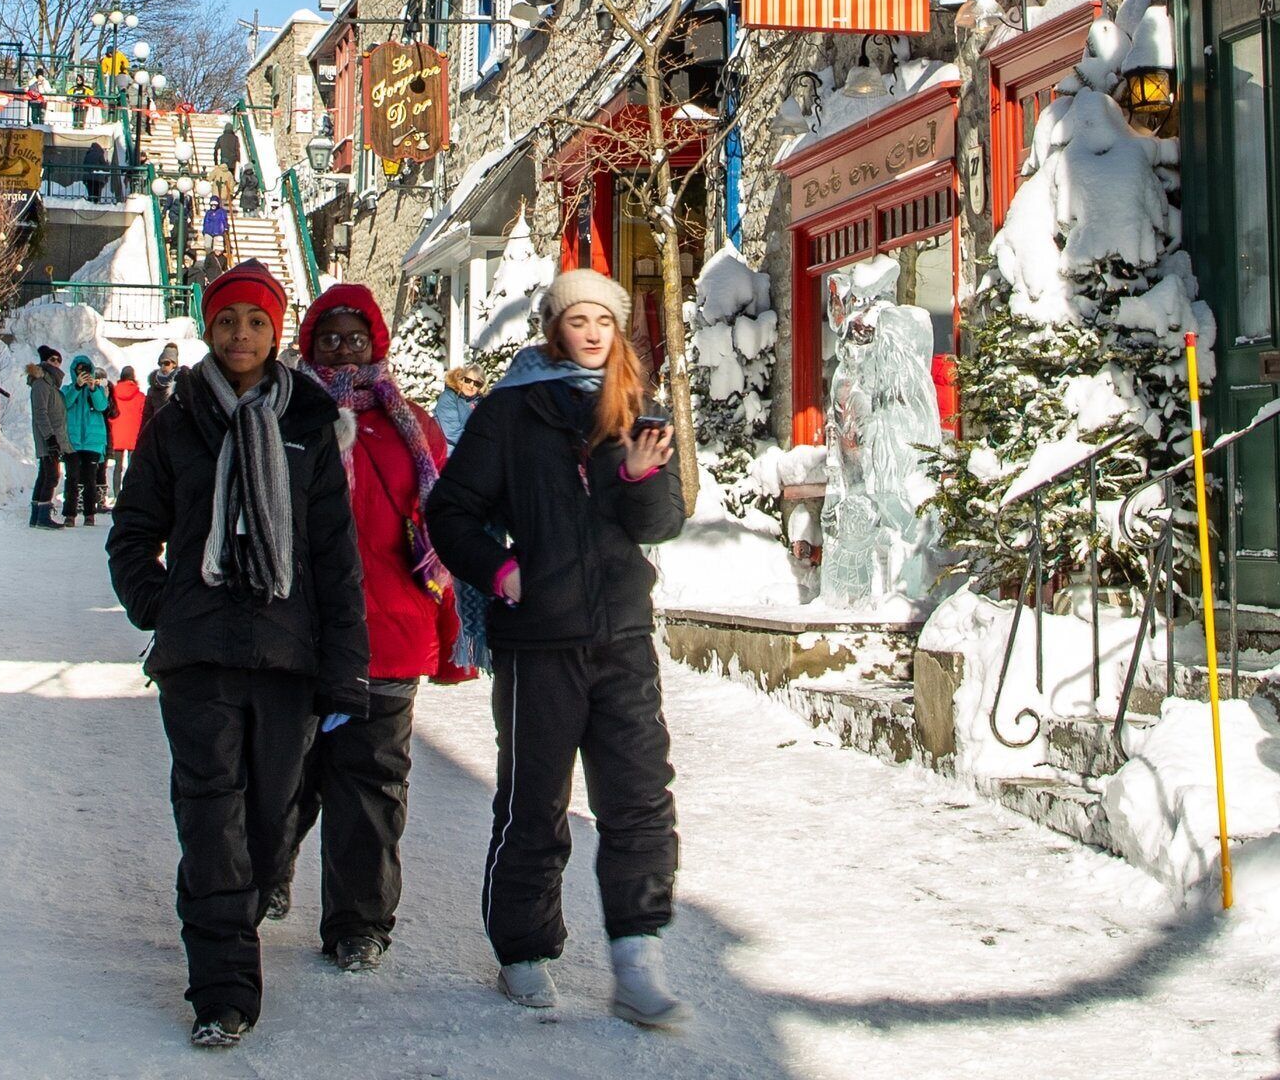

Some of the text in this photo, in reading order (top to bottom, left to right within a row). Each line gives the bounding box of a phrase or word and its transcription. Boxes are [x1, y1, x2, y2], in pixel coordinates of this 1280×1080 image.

[391, 54, 413, 75] Le
[371, 65, 442, 108] Forgeron
[802, 117, 938, 208] Pot en Ciel
